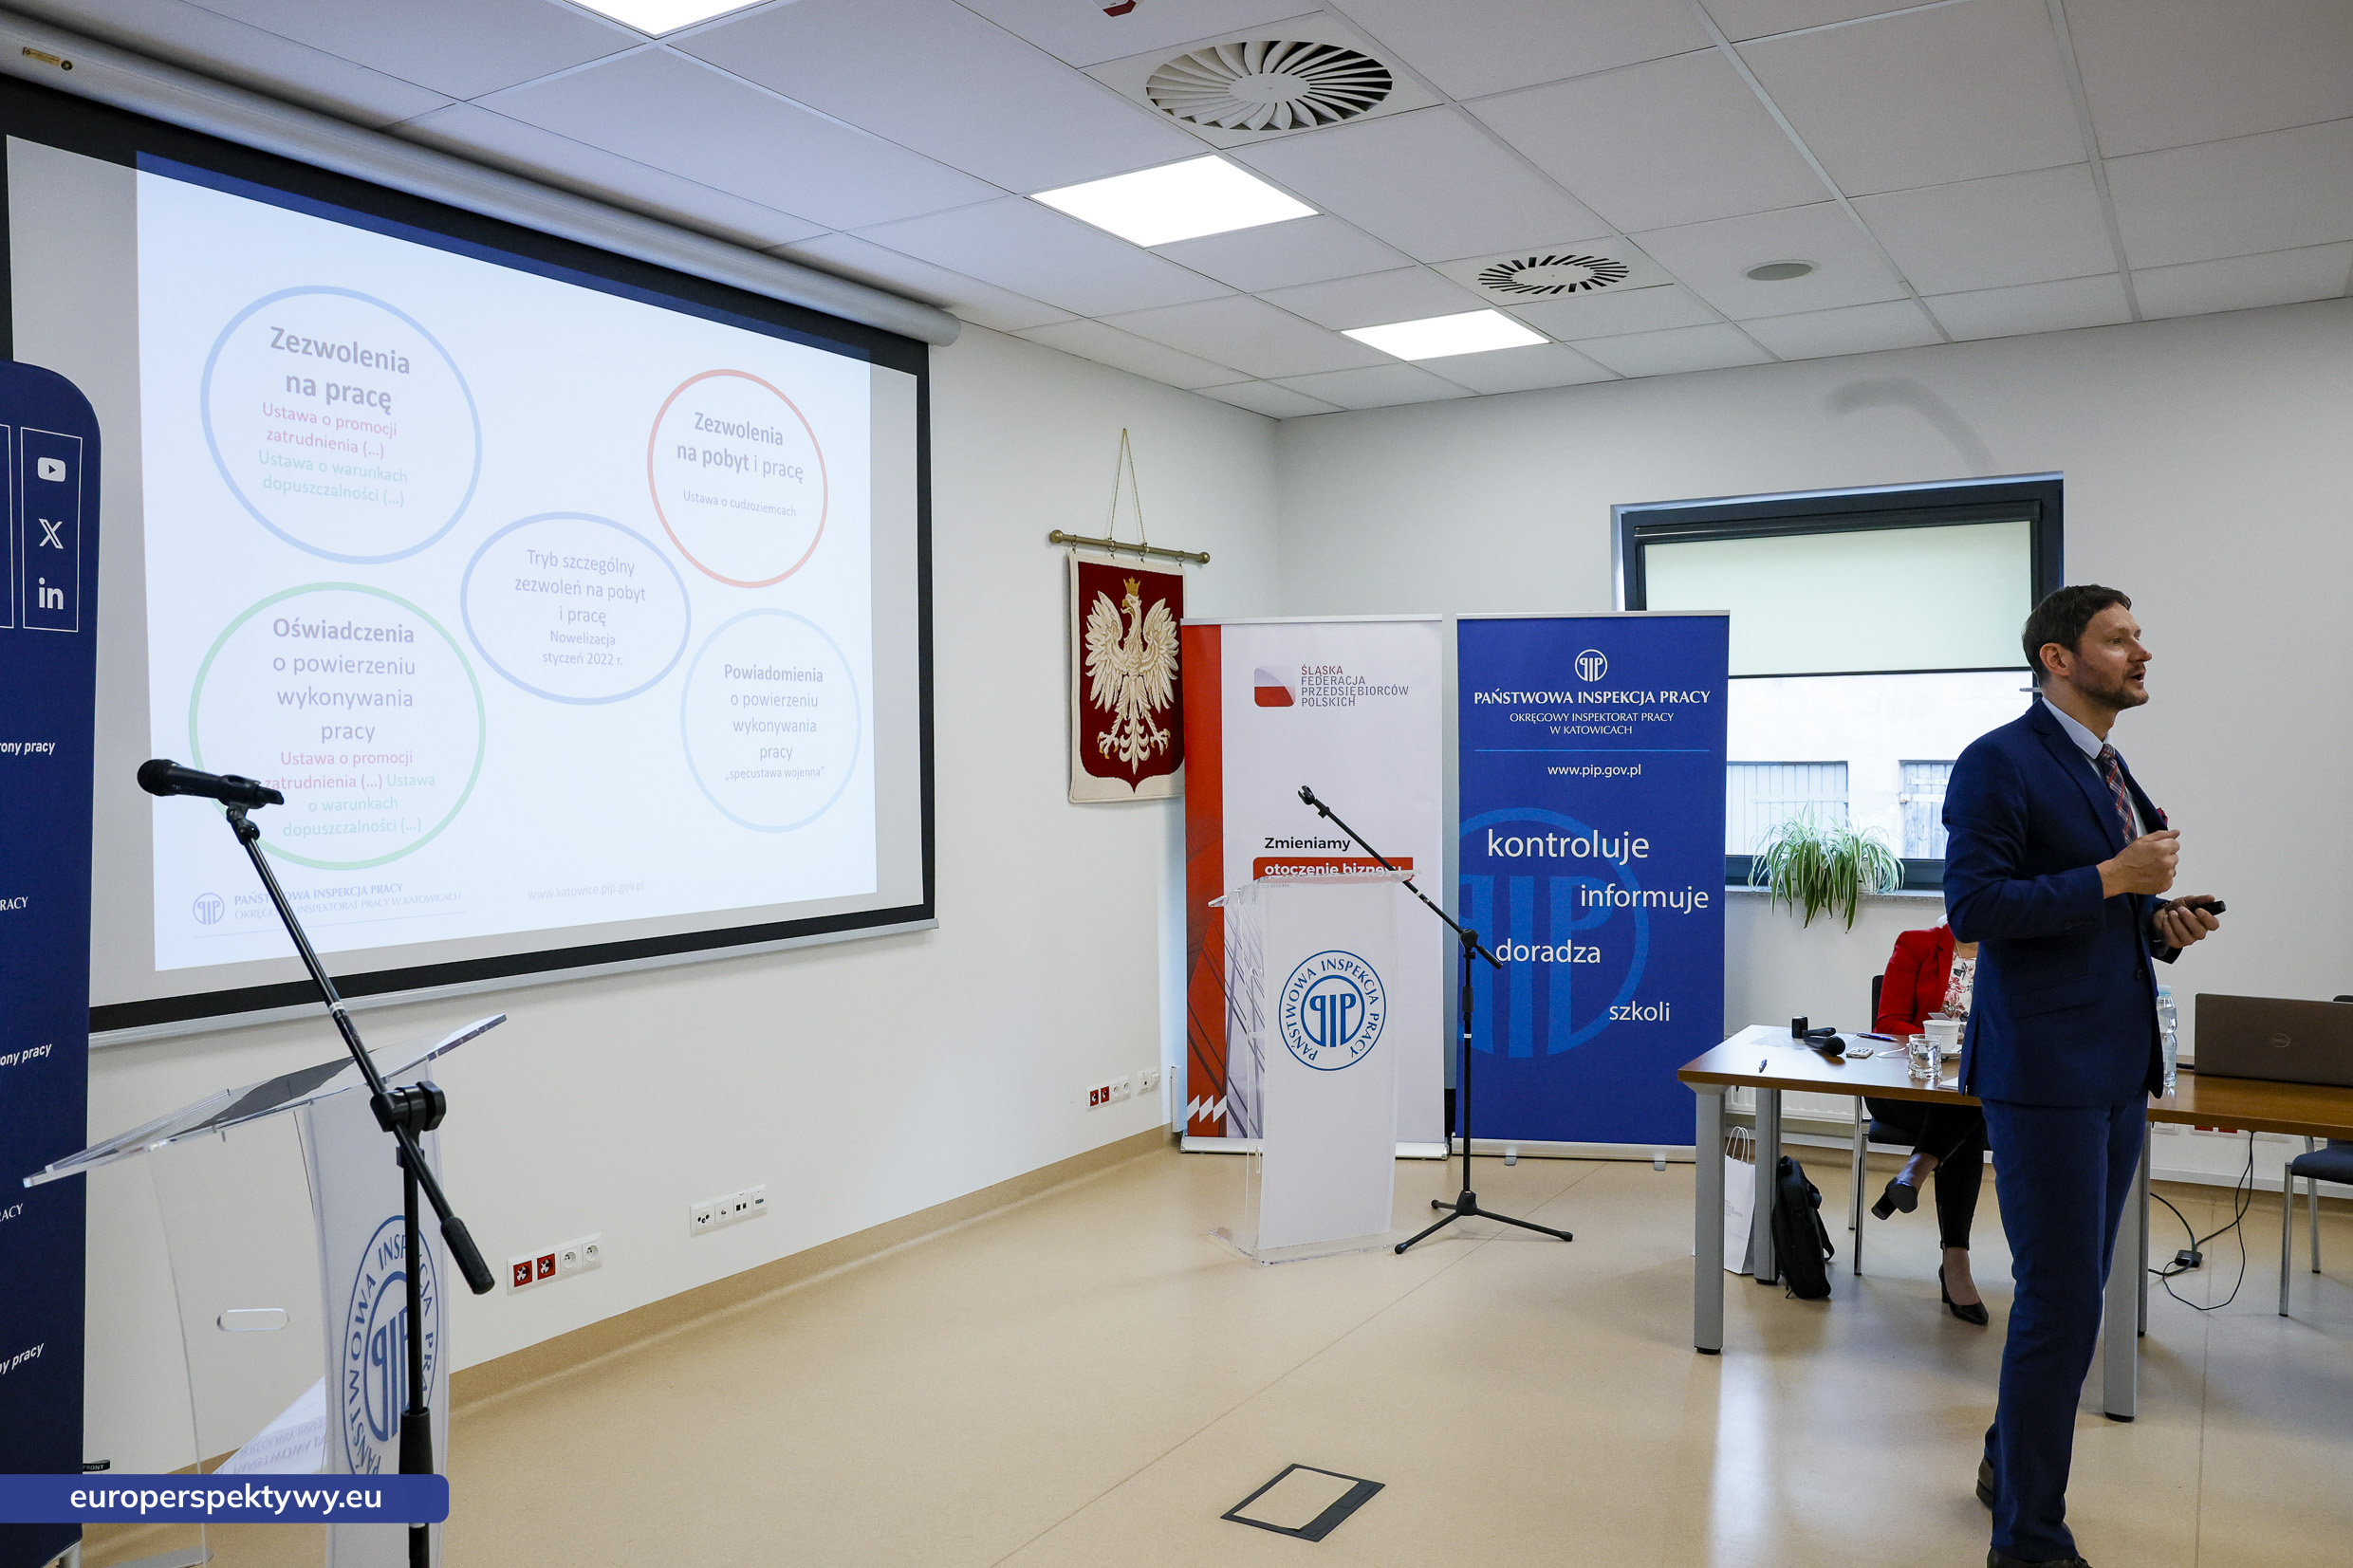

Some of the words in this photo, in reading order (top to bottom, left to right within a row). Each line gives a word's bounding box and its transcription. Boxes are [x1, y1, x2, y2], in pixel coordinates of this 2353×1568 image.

[269, 325, 410, 374] Zezwolenia
[286, 375, 316, 397] na
[325, 379, 392, 415] pracę
[262, 402, 318, 424] Ustawa
[322, 414, 331, 426] o
[335, 416, 398, 439] promocji
[694, 412, 784, 446] Zezwolenia
[266, 428, 359, 453] zatrudnienia
[258, 450, 315, 471] Ustawa
[318, 460, 328, 473] o
[332, 462, 408, 483] warunkach
[676, 443, 697, 462] na
[702, 448, 750, 474] pobyt
[753, 454, 758, 472] i
[762, 459, 804, 484] pracę
[263, 474, 380, 503] dopuszczalności
[683, 489, 719, 507] Ustawa
[721, 497, 728, 507] o
[730, 496, 797, 517] cudzoziemcach
[527, 549, 559, 569] Tryb
[563, 556, 635, 577] szczególny
[39, 577, 64, 609] in
[514, 578, 582, 596] zezwoleń
[586, 584, 603, 598] na
[607, 583, 646, 604] pobyt
[559, 605, 563, 621] i
[567, 608, 606, 627] pracę
[272, 617, 415, 643] Oświadczenia
[550, 630, 616, 649] Nowelizacja
[272, 656, 286, 672] o
[293, 655, 416, 675] powierzeniu
[543, 651, 584, 666] styczeń
[586, 652, 614, 666] 2022
[617, 655, 623, 666] r.
[724, 663, 824, 683] Powiadomienia
[1301, 663, 1343, 676] ŚLĄSKA
[1301, 675, 1366, 686] FEDERACJA
[1301, 683, 1409, 697] PRZEDSIĘBIORCÓW
[277, 686, 414, 710] wykonywania
[730, 693, 738, 707] o
[743, 692, 819, 710] powierzeniu
[1301, 696, 1356, 707] POLSKICH
[1473, 688, 1573, 705] PAŃSTWOWA
[1578, 691, 1656, 707] INSPEKCJA
[1659, 691, 1711, 704] PRACY
[732, 716, 817, 735] wykonywania
[1510, 712, 1569, 724] OKRĘGOWY
[1571, 712, 1638, 722] INSPEKTORAT
[1641, 712, 1675, 722] PRACY
[322, 724, 376, 744] pracy
[1549, 726, 1562, 735] W
[1564, 726, 1633, 735] KATOWICACH
[24, 743, 55, 756] pracy
[280, 751, 335, 766] Ustawa
[339, 754, 348, 766] o
[352, 750, 413, 767] promocji
[760, 747, 793, 762] pracy
[265, 774, 357, 790] zatrudnienia
[386, 773, 435, 788] Ustawa
[1547, 764, 1641, 778] www.pip.gov.pl
[308, 801, 318, 812] o
[322, 796, 398, 813] warunkach
[283, 817, 398, 839] dopuszczalności
[1264, 837, 1351, 852] Zmieniamy
[1488, 828, 1650, 865] kontroluje
[1264, 862, 1339, 876] otoczenie
[234, 890, 311, 906] PAŃSTOWA
[313, 886, 368, 899] INSPEKCJA
[371, 883, 403, 895] PRACY
[528, 879, 645, 900] www.katowice.pip.gov.pl
[1581, 883, 1709, 914] informuje
[297, 901, 359, 914] INSPEKTORAT
[361, 898, 389, 909] PRACY
[392, 897, 401, 906] W
[404, 893, 461, 904] KATOWICACH
[1495, 938, 1601, 964] doradza
[1321, 958, 1380, 1005] INSPEKCJA
[1286, 968, 1318, 1061] PAŃSTWOWA
[1609, 1001, 1670, 1022] szkoli
[1349, 1012, 1380, 1058] PRACY
[22, 1043, 52, 1063] pracy
[11, 1343, 45, 1371] pracy
